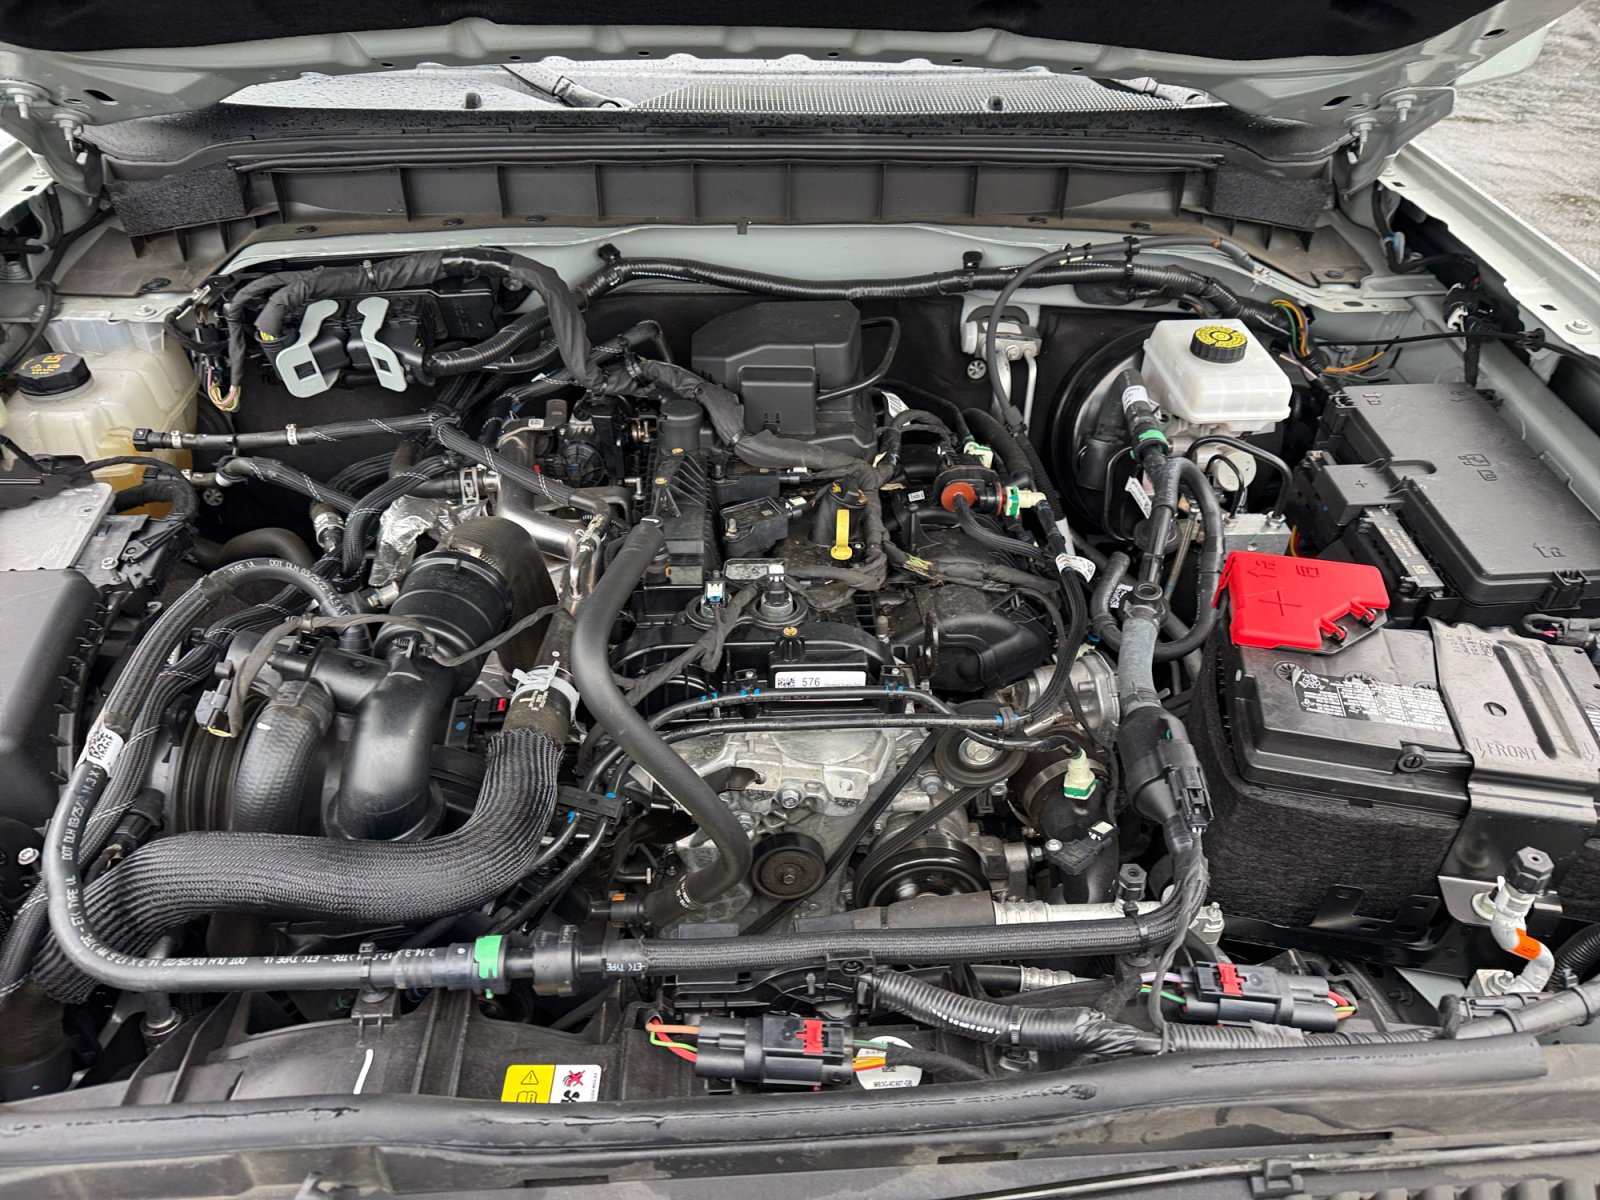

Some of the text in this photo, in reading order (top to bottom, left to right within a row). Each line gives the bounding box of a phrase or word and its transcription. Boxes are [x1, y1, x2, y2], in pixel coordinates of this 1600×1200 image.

[269, 559, 284, 568] DOT
[801, 677, 821, 687] 576
[1486, 742, 1537, 760] FRONT
[61, 845, 74, 861] DOT
[66, 888, 80, 910] TYPE
[228, 957, 249, 966] DOT
[275, 956, 299, 964] TYPE
[605, 962, 625, 972] TYPE
